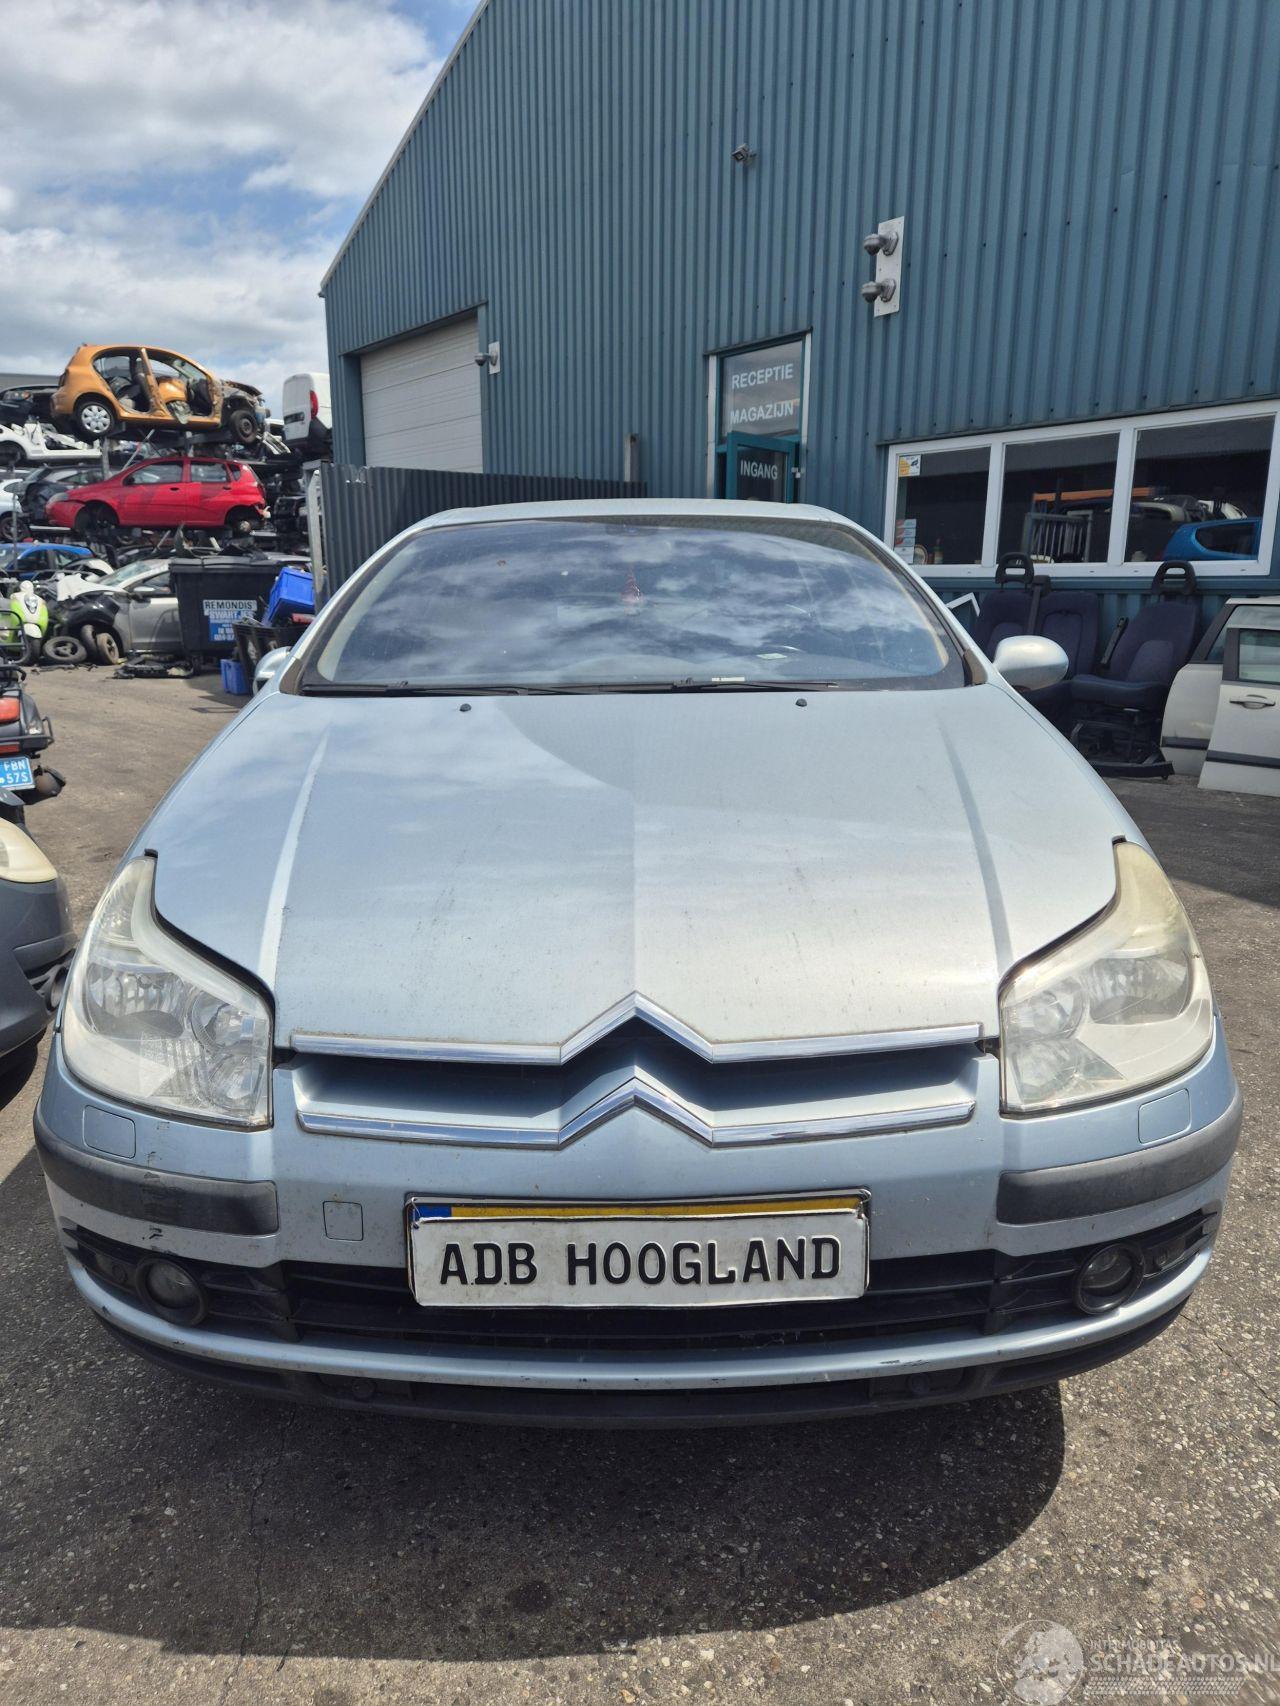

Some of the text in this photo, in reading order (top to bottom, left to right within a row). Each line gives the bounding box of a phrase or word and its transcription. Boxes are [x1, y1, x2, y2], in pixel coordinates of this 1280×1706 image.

[731, 363, 794, 389] RECEPTIE
[729, 401, 794, 425] MAGAZIJN
[740, 459, 778, 481] INGANG
[204, 601, 252, 609] REMONDIS
[567, 1235, 842, 1286] HOOGLAND
